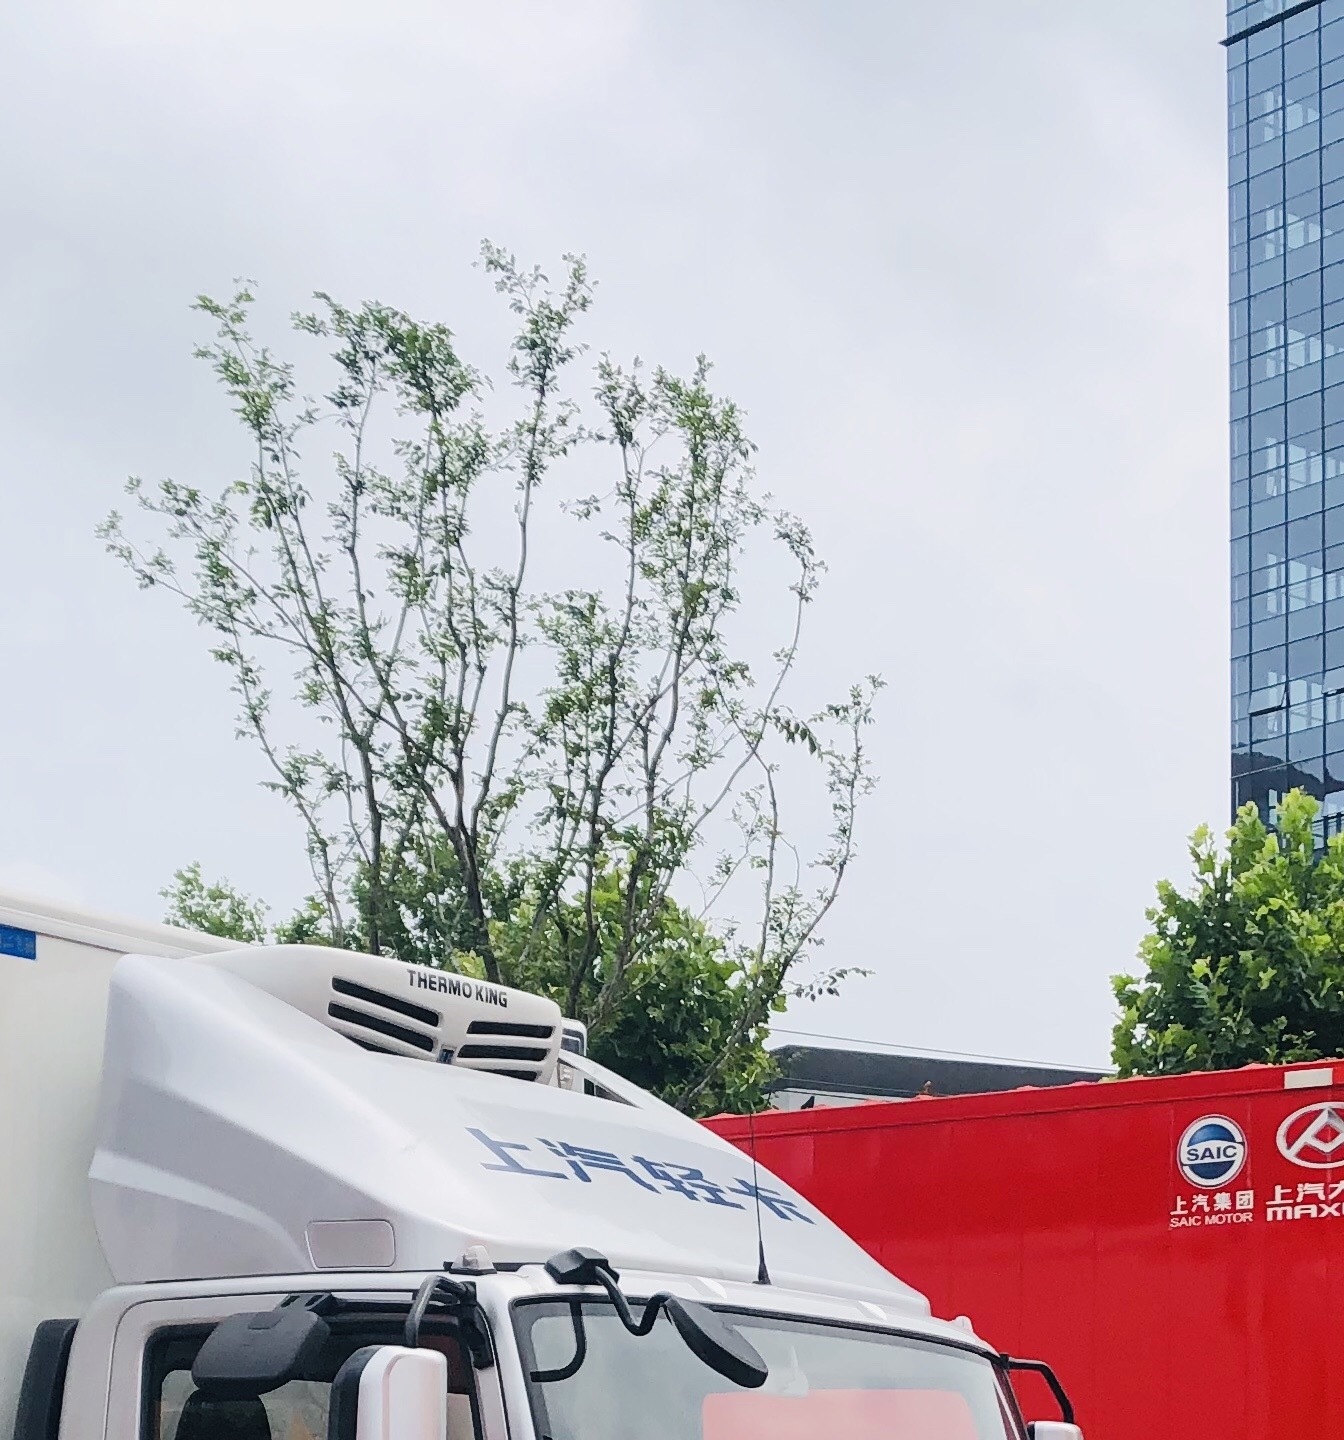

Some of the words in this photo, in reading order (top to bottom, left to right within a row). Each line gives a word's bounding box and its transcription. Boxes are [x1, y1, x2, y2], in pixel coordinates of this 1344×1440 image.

[407, 969, 472, 998] THERMO
[475, 984, 508, 1008] KING
[1186, 1145, 1238, 1162] SAIC
[465, 1126, 816, 1225] 上汽轻卡
[1170, 1189, 1254, 1215] 上汽集团
[1170, 1215, 1202, 1228] SAIC
[1205, 1212, 1254, 1226] MOTOR
